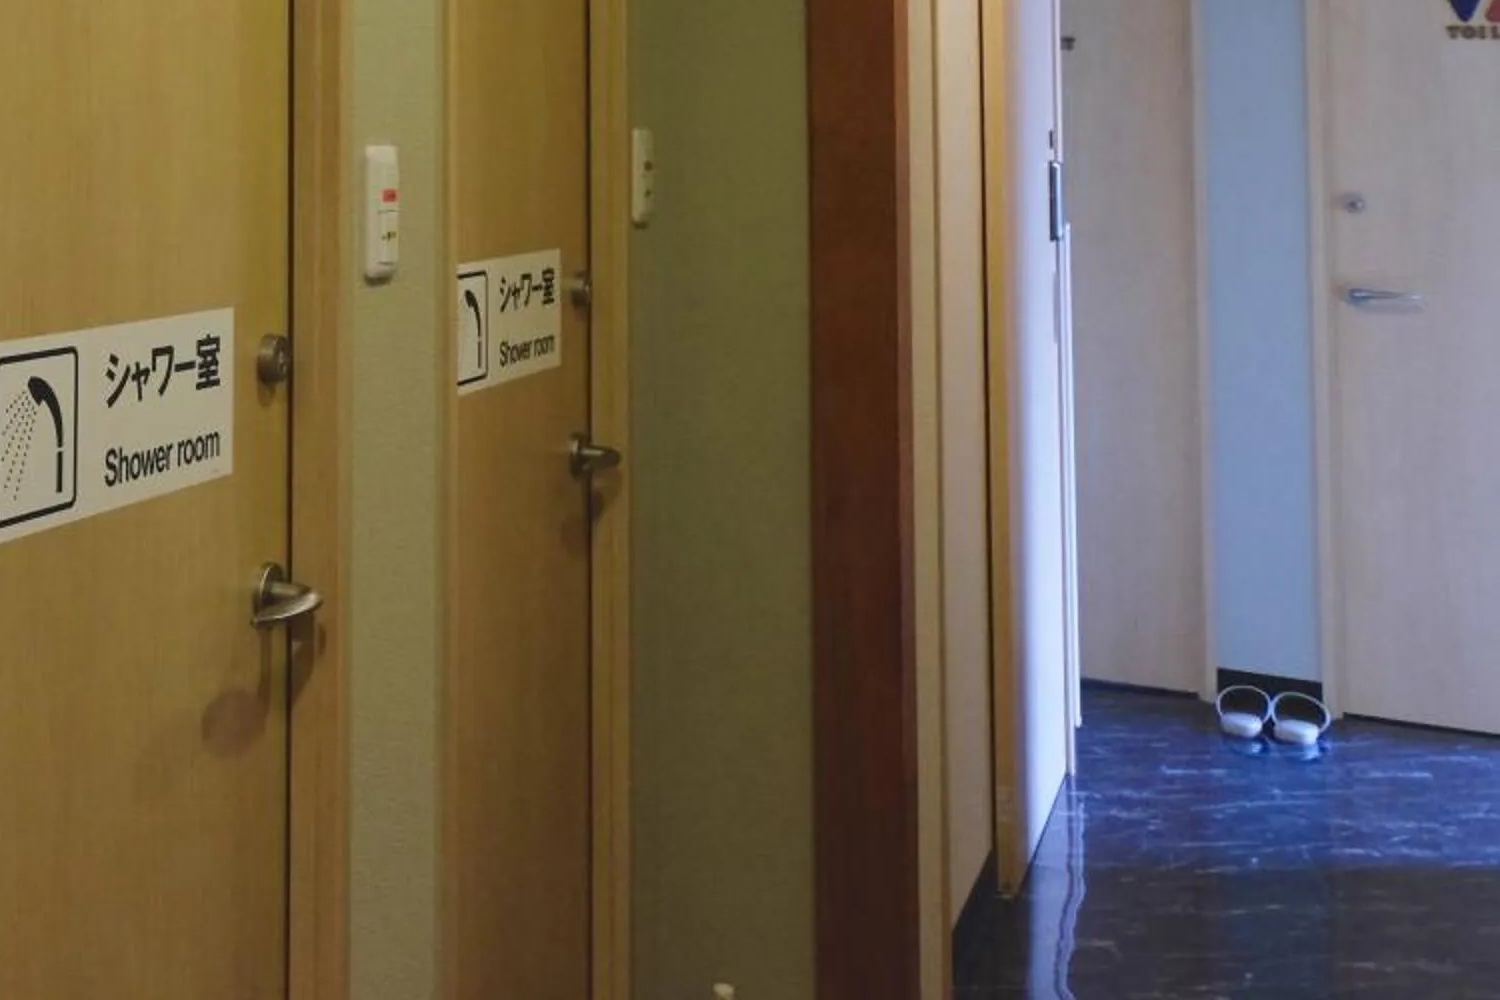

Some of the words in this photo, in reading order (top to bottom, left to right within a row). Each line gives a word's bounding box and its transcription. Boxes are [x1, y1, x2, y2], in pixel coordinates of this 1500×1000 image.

[500, 267, 555, 312] シャワー室
[105, 333, 221, 408] シャワー室
[500, 339, 533, 367] Shower
[533, 334, 555, 357] room
[104, 442, 174, 487] Shower
[177, 430, 221, 467] room
